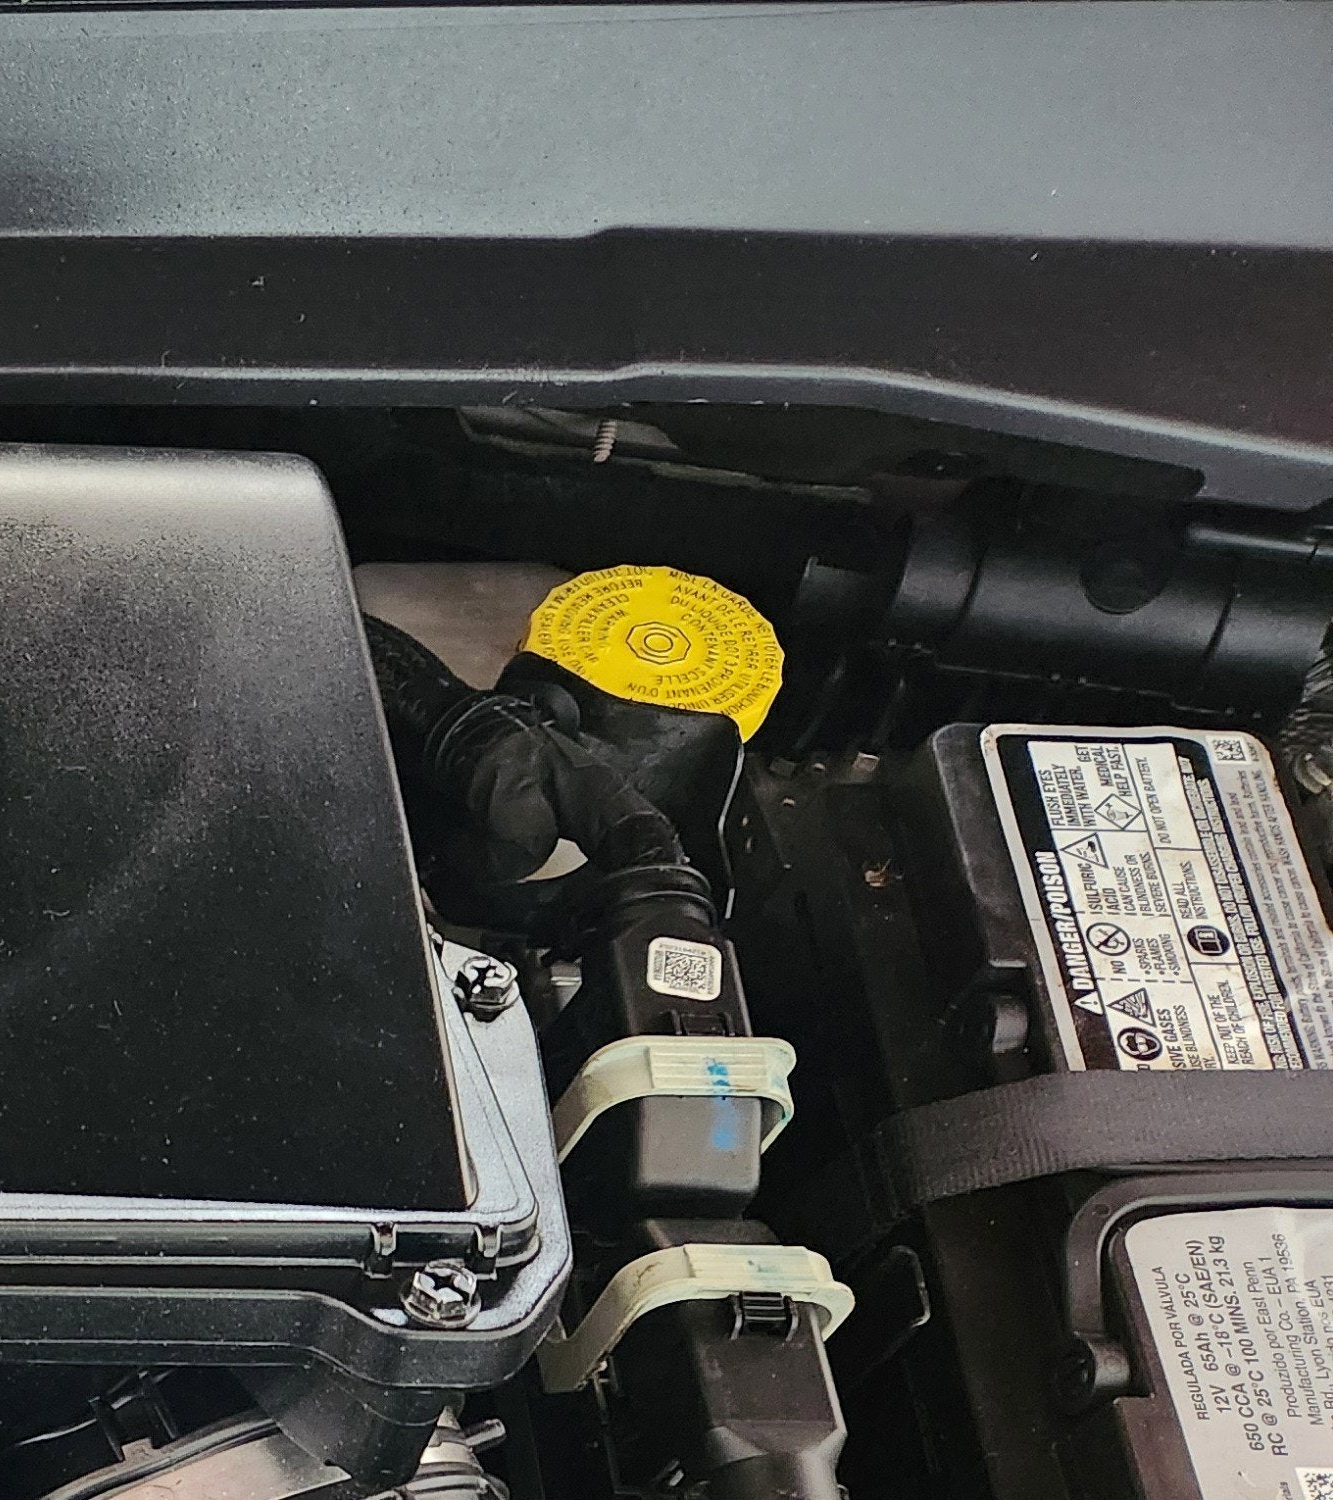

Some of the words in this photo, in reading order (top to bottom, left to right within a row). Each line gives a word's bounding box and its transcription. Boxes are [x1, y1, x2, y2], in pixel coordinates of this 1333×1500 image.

[673, 584, 719, 607] AVANT
[1074, 745, 1091, 761] GET
[1089, 745, 1114, 786] MEDICAL
[1104, 746, 1124, 770] FAST.
[1037, 769, 1056, 791] EYES
[1066, 765, 1089, 799] WATER.
[1113, 773, 1132, 795] HELP
[1050, 763, 1081, 825] IMMEDIATELY
[1145, 793, 1162, 813] OPEN
[1045, 796, 1066, 825] FLUSH
[1078, 803, 1097, 826] WITH
[1151, 816, 1167, 830] NOT
[1157, 833, 1171, 842] DO
[1124, 854, 1137, 864] OR
[1076, 862, 1103, 909] SULFURIC
[1112, 866, 1131, 891] CAUSE
[1128, 867, 1152, 911] BLINDNESS
[1171, 881, 1186, 895] ALL
[1101, 888, 1121, 910] ACID
[1121, 895, 1136, 910] CAN
[1147, 882, 1167, 911] SEVERE
[1175, 898, 1193, 919] READ
[1033, 851, 1095, 989] DANGER/POISON
[1110, 960, 1127, 973] NO
[1207, 994, 1223, 1008] THE
[1155, 1008, 1178, 1041] GASES
[1172, 1005, 1197, 1051] BLINDNESS
[1212, 1011, 1227, 1022] OF
[1230, 1023, 1245, 1033] OF
[1216, 1024, 1233, 1039] OUT
[1222, 1042, 1240, 1064] KEEP
[1234, 1037, 1255, 1064] REACH
[1205, 1235, 1227, 1253] kg
[1271, 1234, 1293, 1270] 19536
[1184, 1240, 1223, 1307] (SAE/EN)
[1213, 1258, 1235, 1286] 21.3
[1241, 1261, 1261, 1292] Penn
[1261, 1267, 1282, 1294] EUA
[1284, 1277, 1299, 1292] PA
[1150, 1266, 1178, 1319] VÁLVULA
[1174, 1273, 1199, 1307] 25°C
[1303, 1280, 1324, 1307] EUA
[1186, 1313, 1205, 1325] @
[1222, 1291, 1250, 1333] MINS.
[1251, 1297, 1272, 1324] East
[1275, 1310, 1293, 1330] Co.
[1168, 1322, 1187, 1347] POR
[1263, 1329, 1284, 1348] por
[1193, 1332, 1219, 1370] 65Ah
[1239, 1338, 1259, 1363] 100
[1224, 1363, 1241, 1375] @
[1309, 1349, 1331, 1378] Lyon
[1178, 1351, 1210, 1419] REGULADA
[1247, 1370, 1272, 1406] 25°C
[1270, 1353, 1301, 1417] Produzido
[1284, 1335, 1324, 1425] Manufacturing
[1209, 1384, 1232, 1412] 12V
[1230, 1383, 1255, 1417] CCA
[1260, 1413, 1279, 1425] @
[1243, 1423, 1265, 1450] 650
[1267, 1432, 1288, 1455] RC
